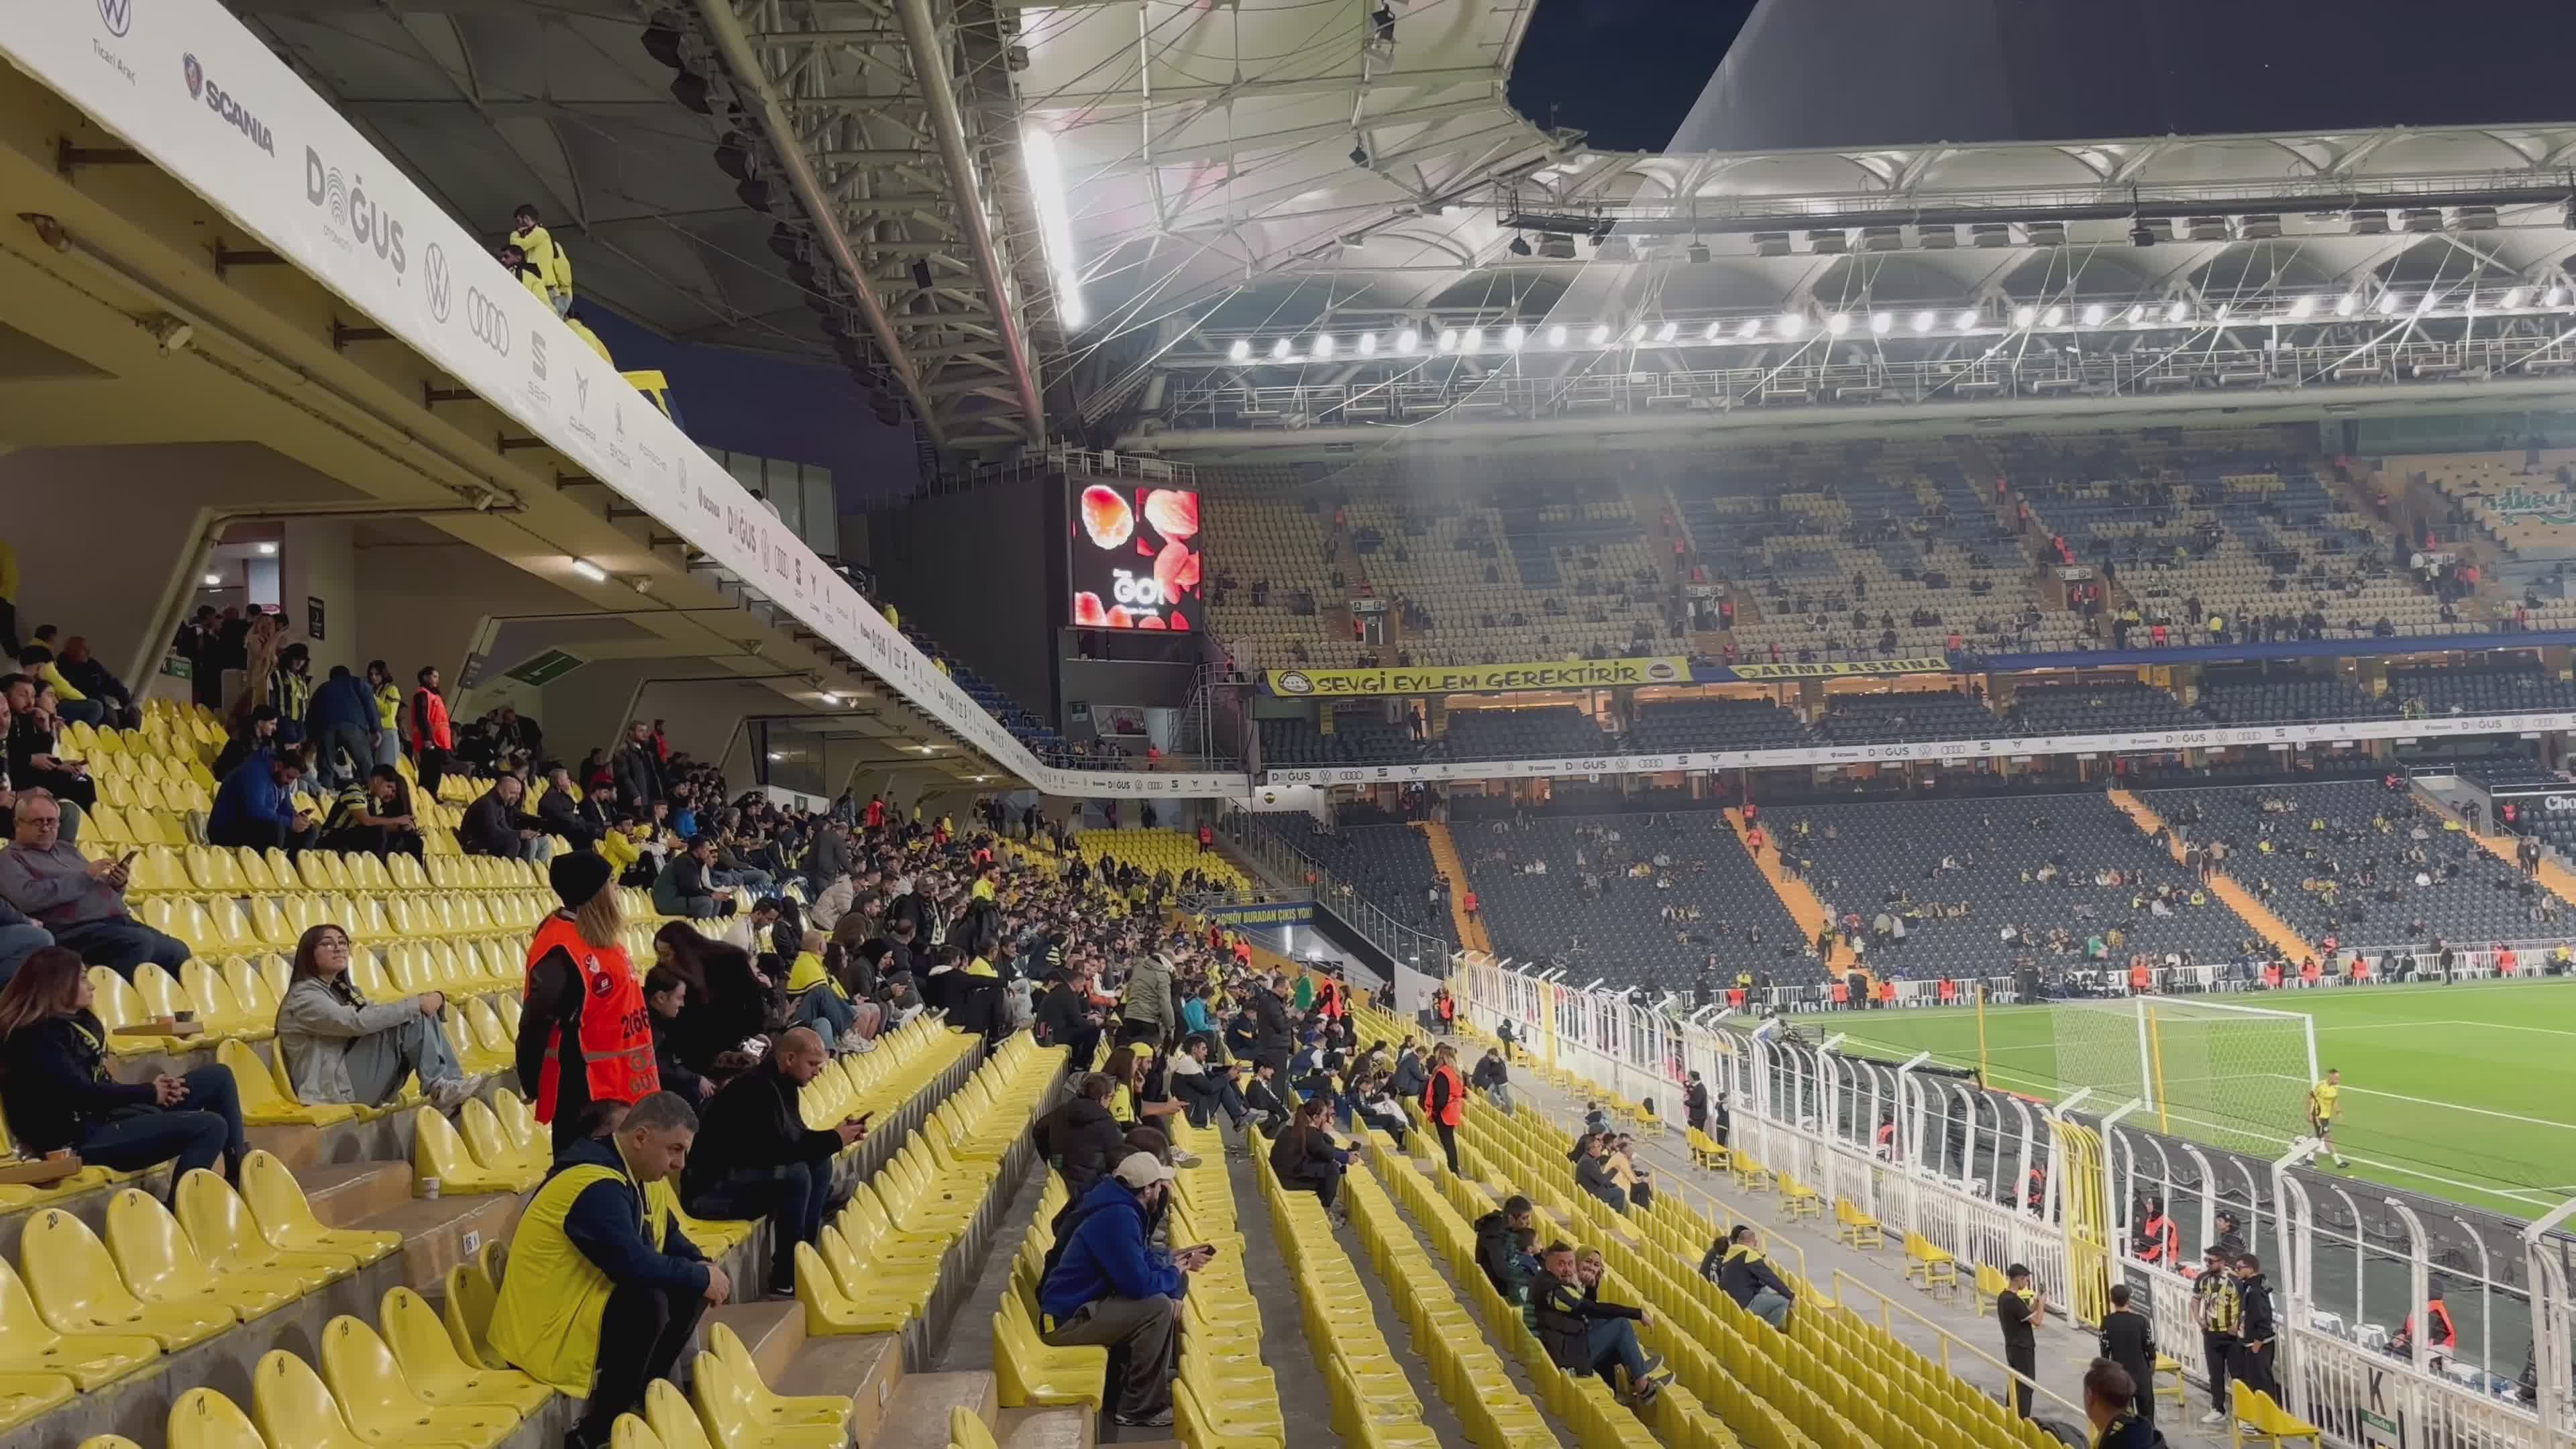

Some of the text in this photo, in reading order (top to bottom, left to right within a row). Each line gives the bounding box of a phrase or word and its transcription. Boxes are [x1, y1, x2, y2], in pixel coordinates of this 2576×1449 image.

[93, 38, 136, 87] Ticari Araç
[206, 80, 274, 158] SCANIA
[1316, 671, 1386, 692] SEVGİ
[1393, 674, 1477, 690] EYLEM
[1486, 661, 1641, 688] GEREKTİRİR
[1762, 663, 1838, 677] ARMA
[1243, 910, 1277, 924] BURADAN
[1277, 908, 1297, 923] ÇIKIŞ
[1297, 906, 1313, 919] YOK!
[46, 1212, 58, 1230] 20
[340, 1321, 349, 1337] 19
[2368, 1366, 2387, 1416] K
